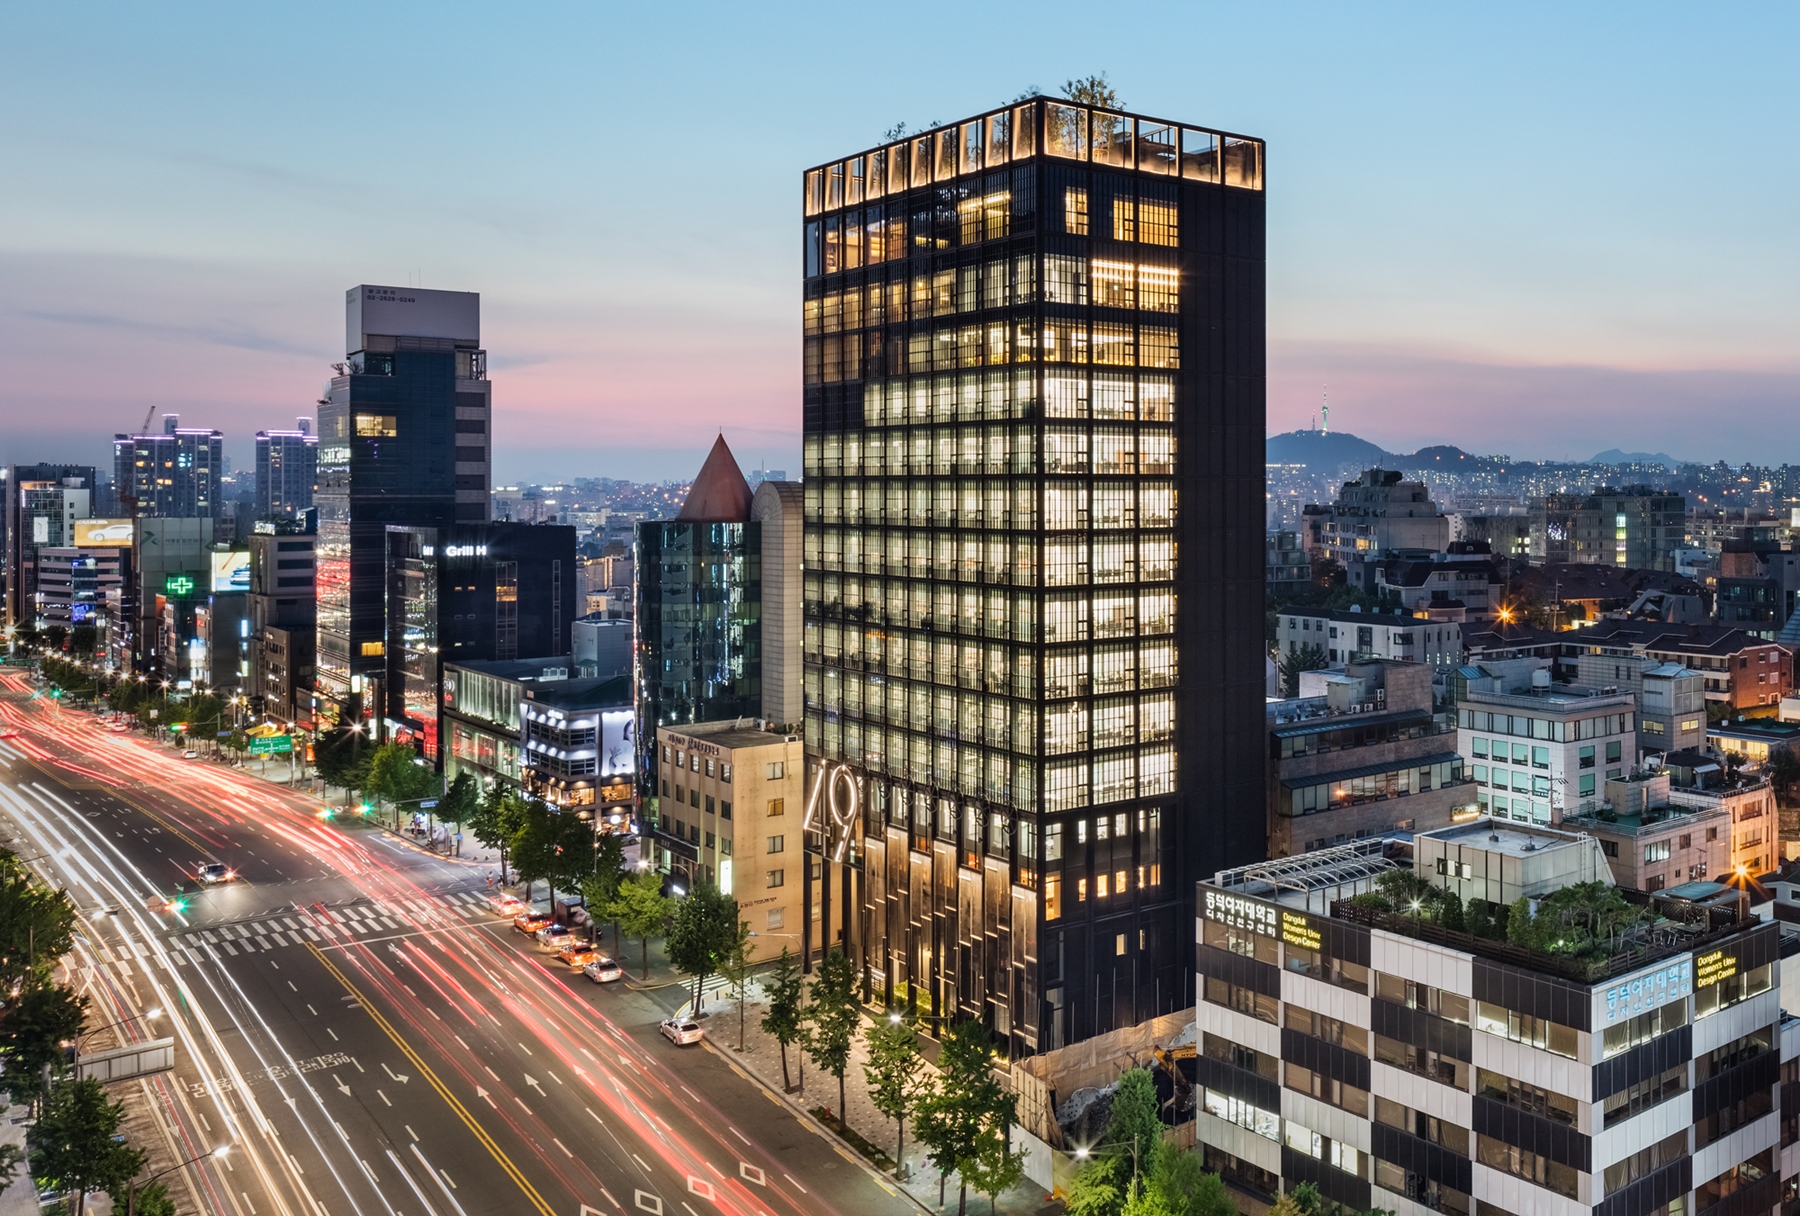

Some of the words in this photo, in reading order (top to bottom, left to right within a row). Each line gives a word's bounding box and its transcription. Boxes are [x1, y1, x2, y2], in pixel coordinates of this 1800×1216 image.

[366, 294, 416, 303] 02-2628-0249
[445, 545, 474, 557] Grill
[476, 545, 487, 556] H
[803, 757, 858, 864] 49
[1205, 891, 1277, 925] 동덕여자대학교
[1206, 909, 1276, 938] 디자인연구센터
[1282, 912, 1307, 926] Dongduk
[1282, 921, 1307, 936] Women's
[1282, 931, 1302, 945] Design
[1302, 936, 1321, 949] Center
[1697, 950, 1723, 967] Dongduk
[1697, 961, 1723, 977] Women's
[1697, 974, 1717, 988] Design
[1717, 967, 1736, 980] Center
[1606, 961, 1691, 1011] 동덕여자대학교
[1606, 982, 1690, 1022] 디자인연구센터
